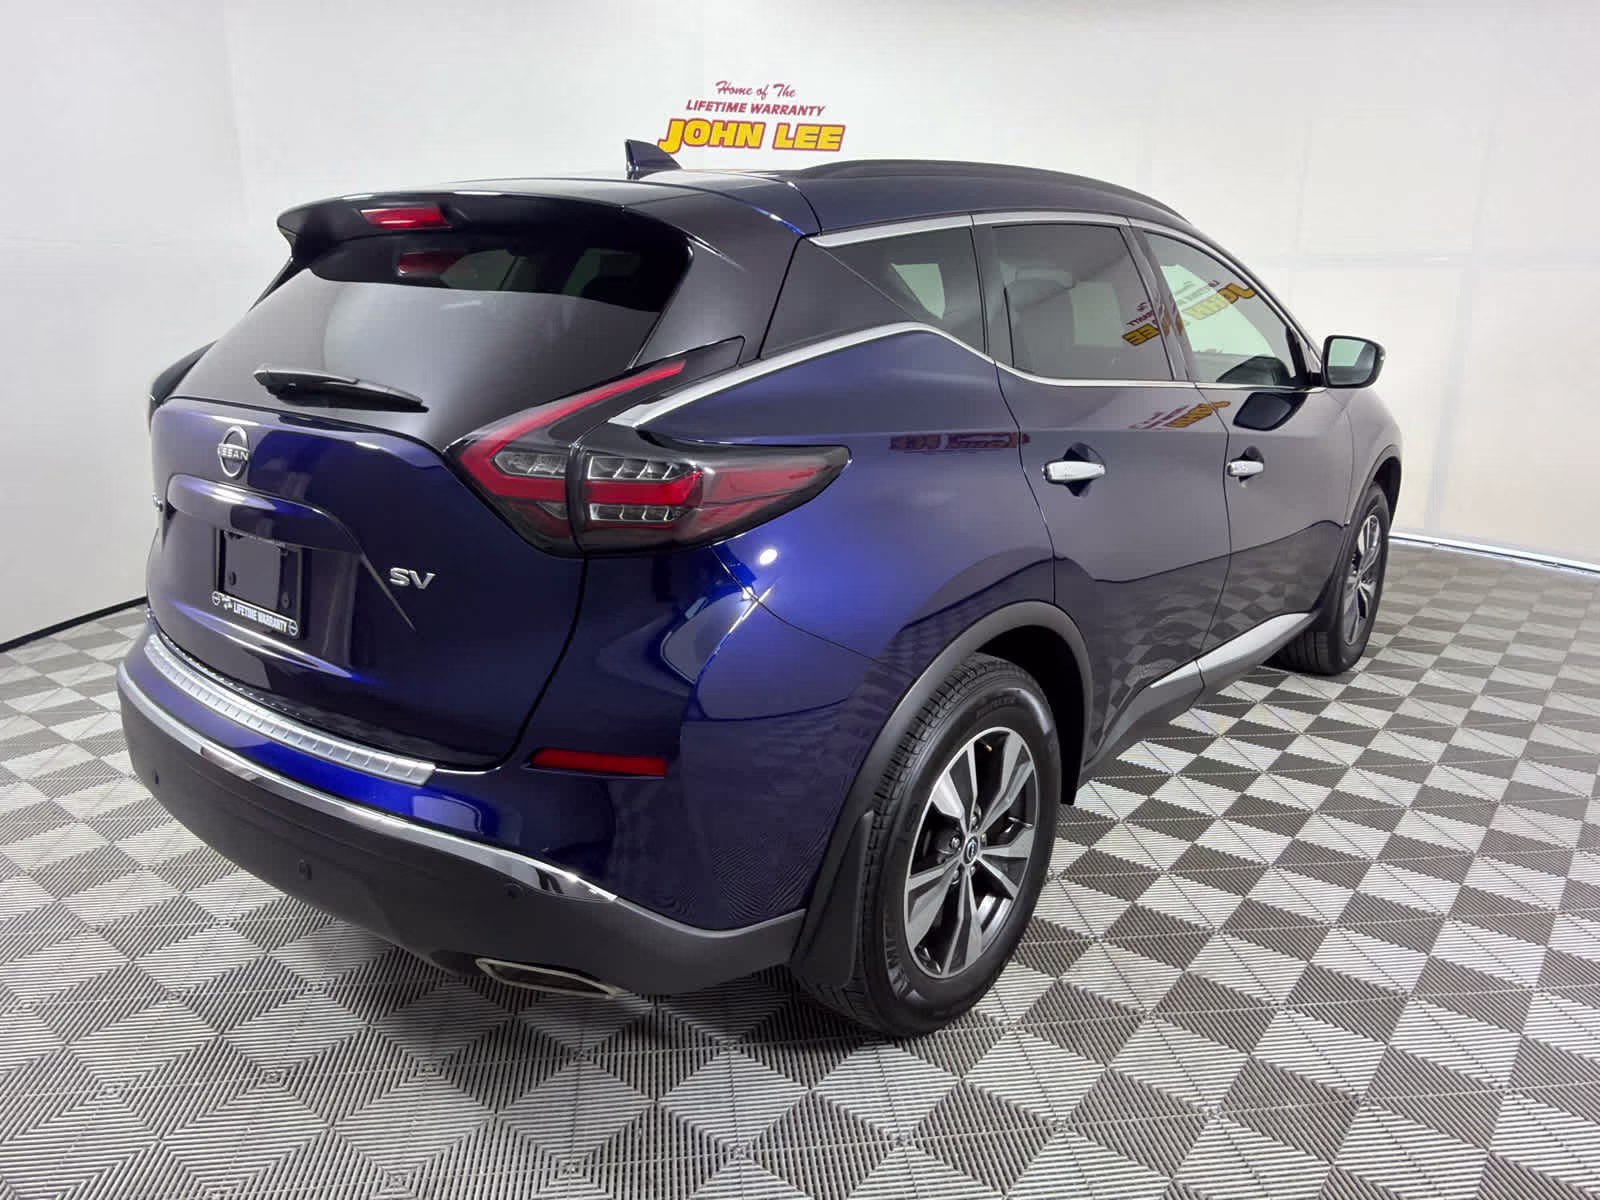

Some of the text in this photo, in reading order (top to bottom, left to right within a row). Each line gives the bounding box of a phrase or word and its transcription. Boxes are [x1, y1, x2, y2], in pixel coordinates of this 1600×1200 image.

[715, 80, 796, 100] Home of The
[686, 99, 825, 117] LIFETIME WARRANTY
[657, 118, 846, 155] JOHN LEE
[390, 567, 436, 590] SV
